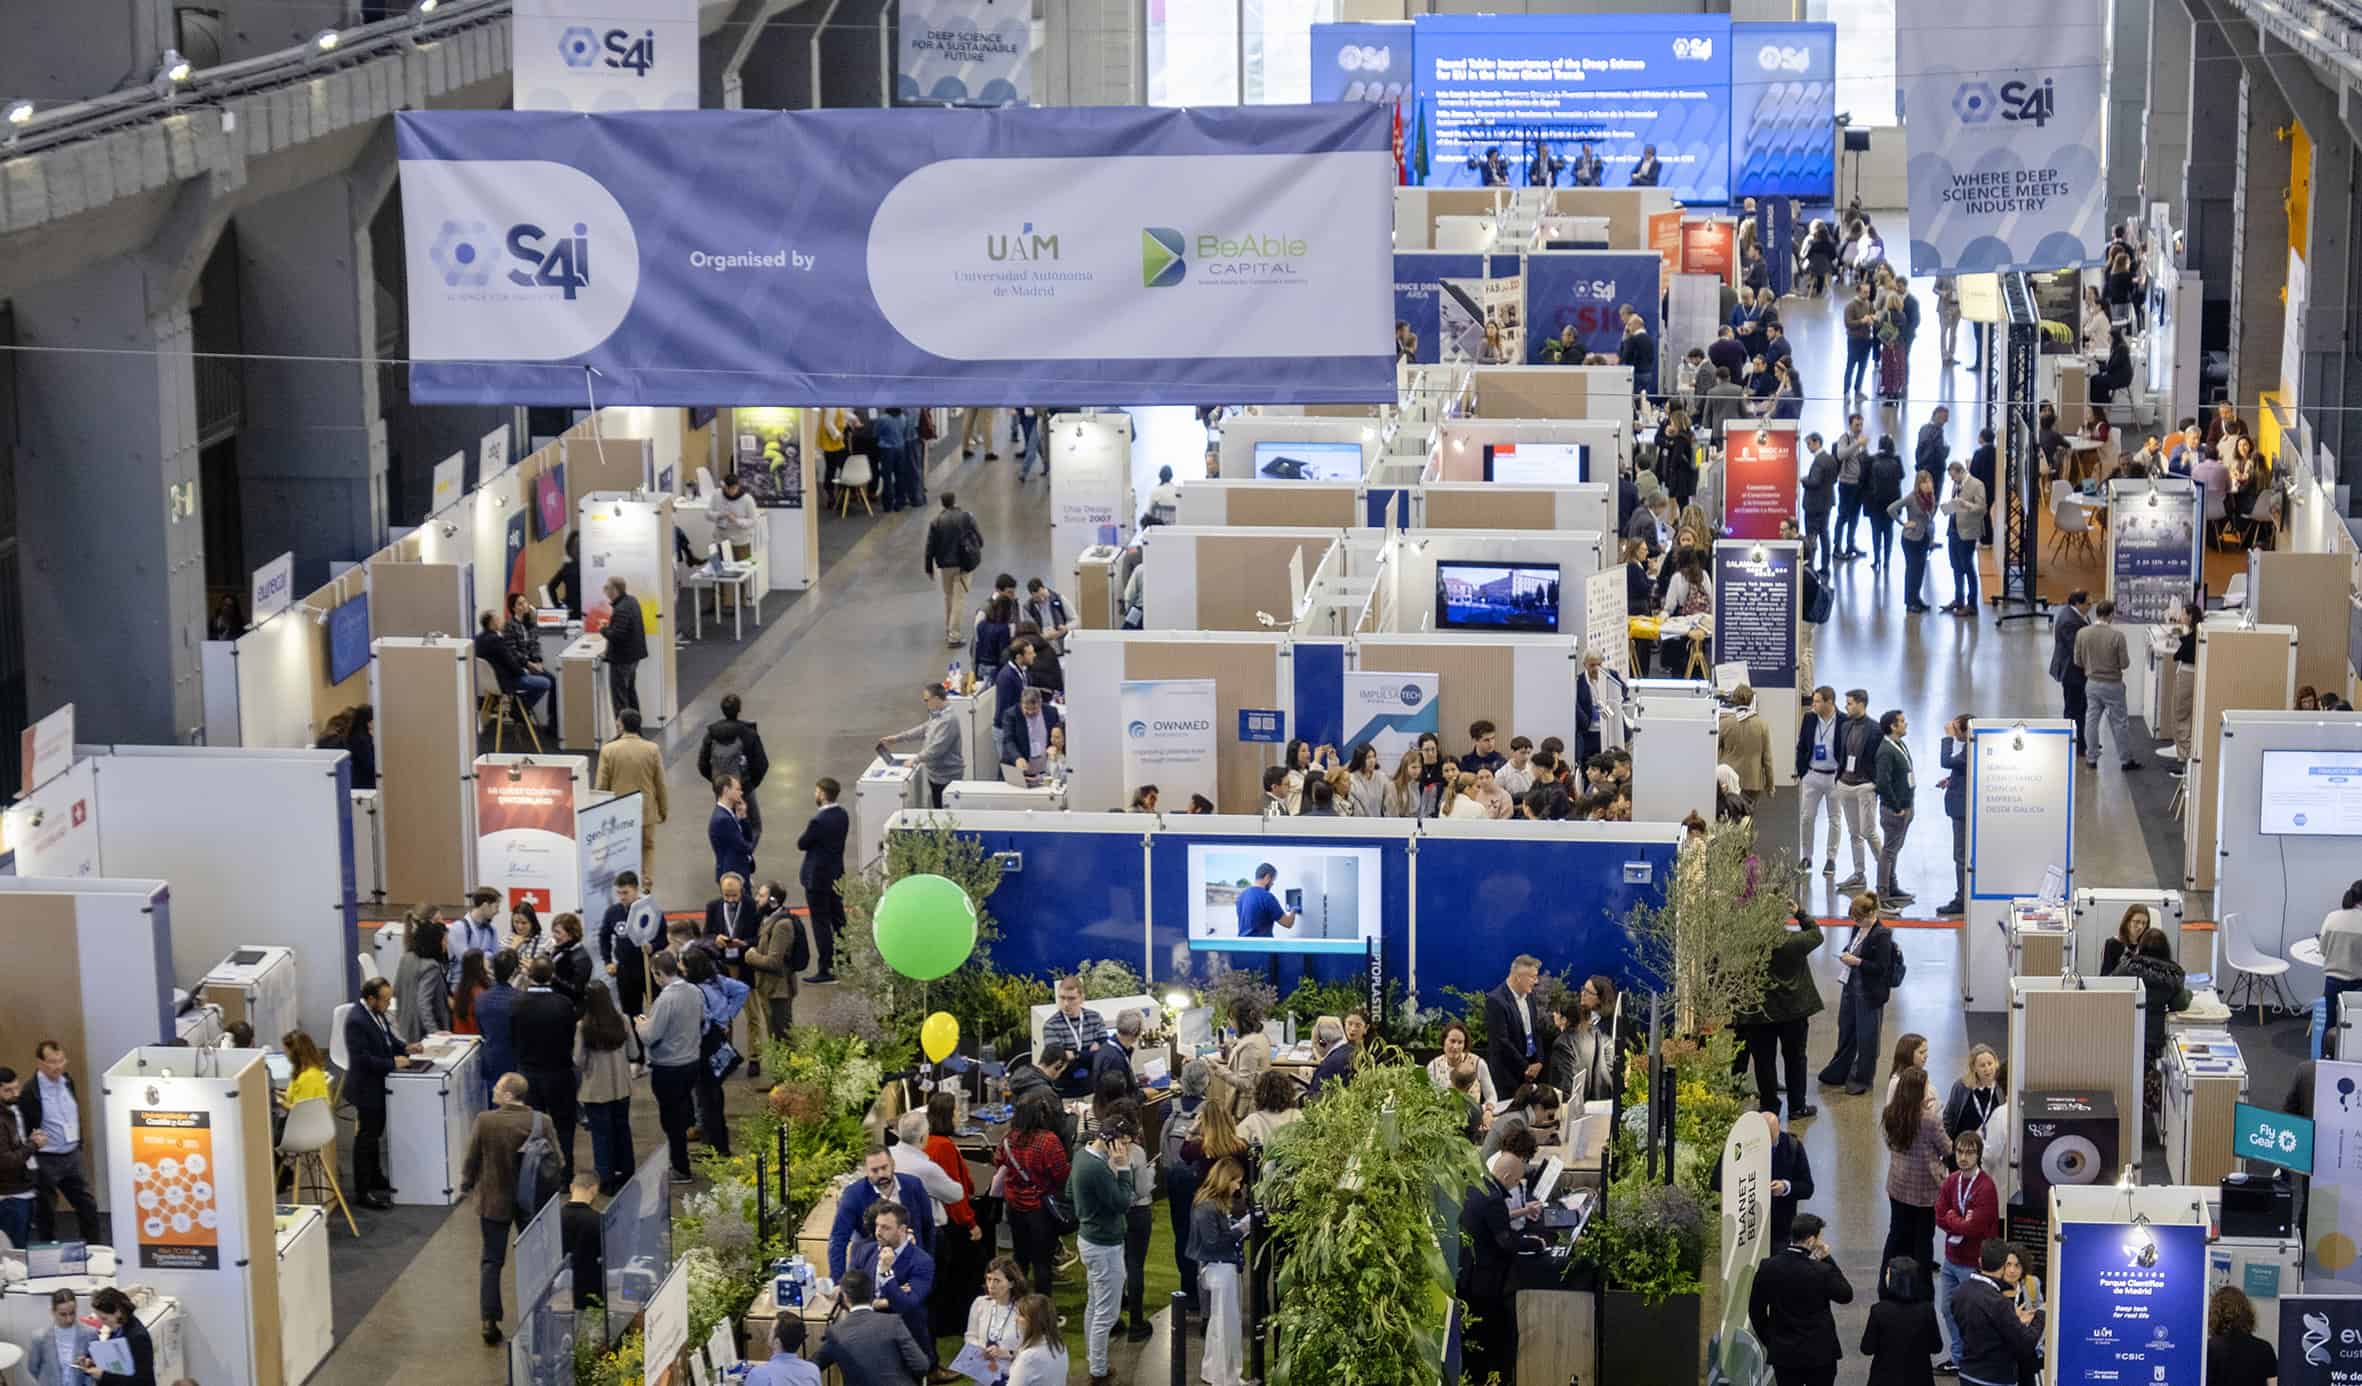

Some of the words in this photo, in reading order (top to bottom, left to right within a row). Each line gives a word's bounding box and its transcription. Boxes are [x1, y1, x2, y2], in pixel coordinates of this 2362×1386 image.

[927, 31, 954, 41] DEEP
[958, 31, 1002, 43] SCIENCE
[603, 28, 654, 77] S4i
[911, 39, 933, 49] FOR
[935, 41, 945, 50] A
[947, 41, 1017, 54] SUSTAINABLE
[943, 51, 985, 62] FUTURE
[2000, 77, 2055, 128] S4i
[1951, 170, 2010, 187] WHERE
[2015, 168, 2058, 184] DEEP
[1942, 184, 2010, 202] SCIENCE
[2015, 182, 2069, 198] MEETS
[1965, 198, 2047, 216] INDUSTRY
[1197, 233, 1308, 259] BeAble
[506, 221, 591, 300] S4i
[690, 250, 785, 271] Organised
[791, 251, 816, 272] by
[953, 268, 1027, 282] Universidad
[1031, 269, 1094, 282] Autónoma
[1208, 263, 1297, 275] CAPITAL
[993, 285, 1008, 297] de
[1010, 285, 1055, 297] Madrid
[1088, 514, 1112, 523] 2007
[1153, 720, 1209, 732] OWNMED
[2259, 1123, 2276, 1139] Fly
[2250, 1133, 2276, 1149] Gear
[1738, 1176, 1748, 1248] PLANET
[1747, 1169, 1756, 1241] BEABLE
[2125, 1287, 2153, 1296] Madrid
[2331, 1371, 2348, 1380] We
